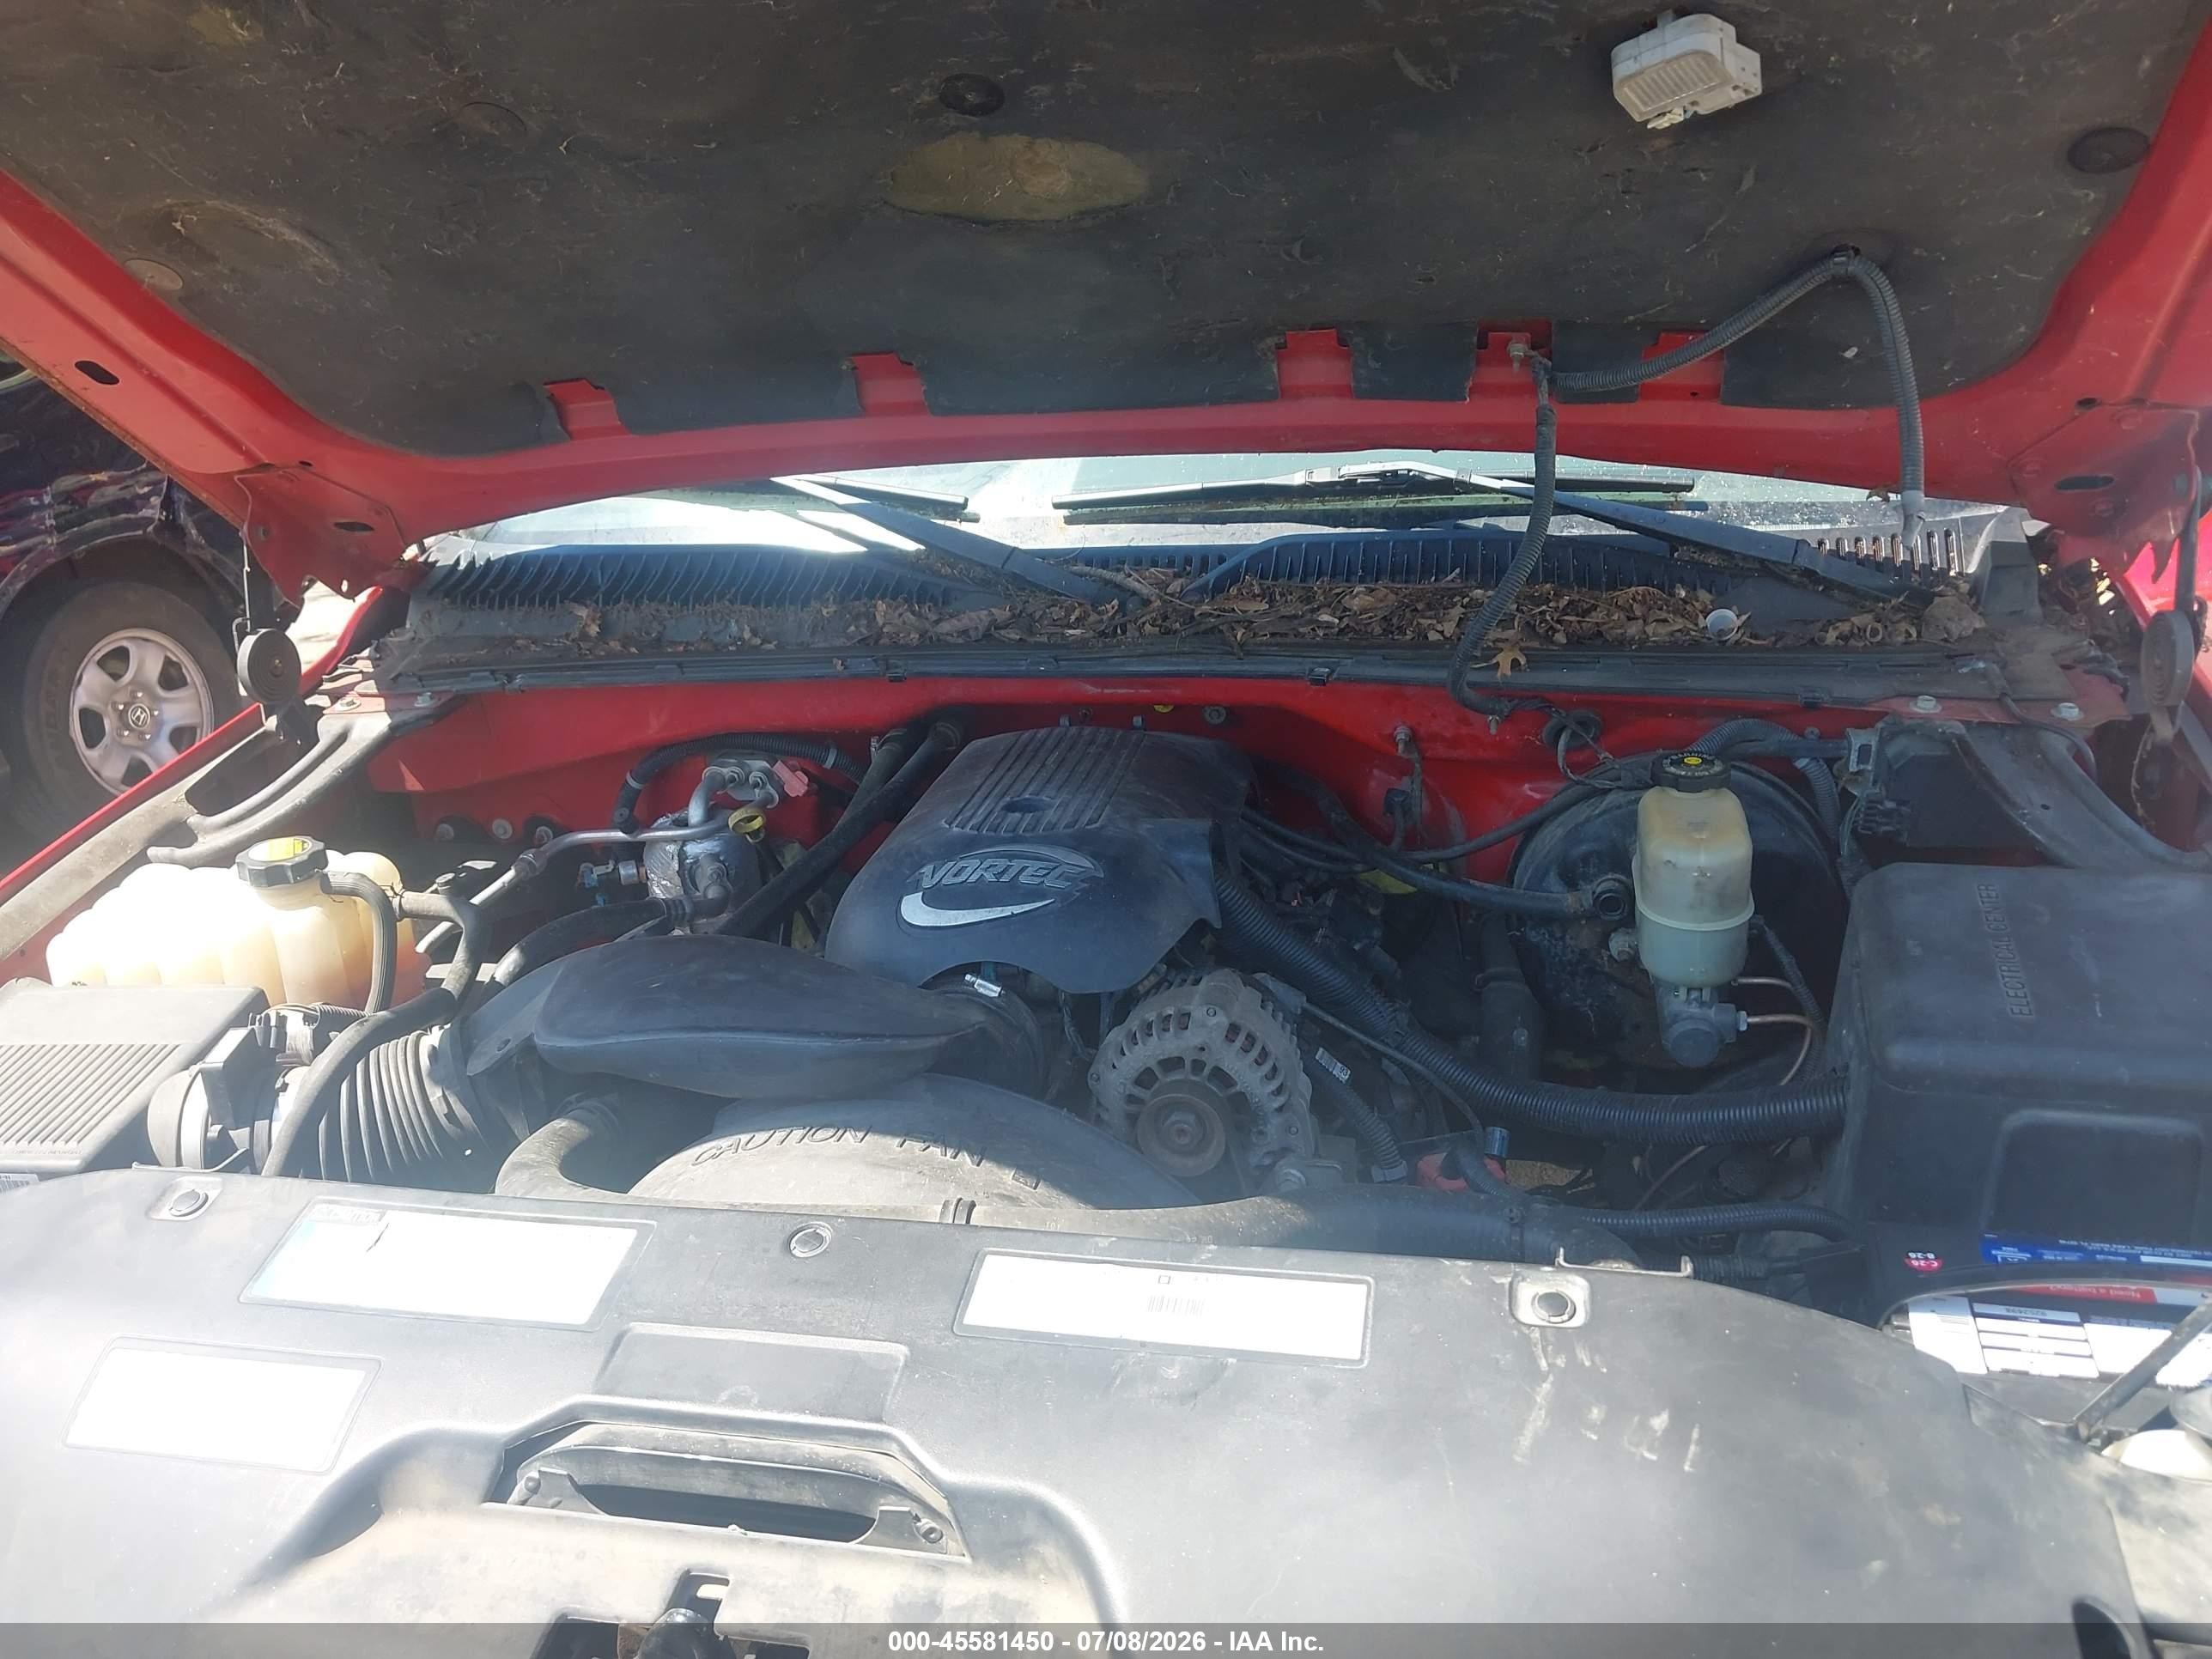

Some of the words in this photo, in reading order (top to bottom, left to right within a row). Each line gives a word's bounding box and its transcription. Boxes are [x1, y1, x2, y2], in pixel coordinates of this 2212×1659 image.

[916, 858, 1091, 890] VORTEC
[1978, 884, 2009, 932] CENTER
[1992, 934, 2033, 1017] ELECTRICAL
[691, 1125, 873, 1167] CAUTION
